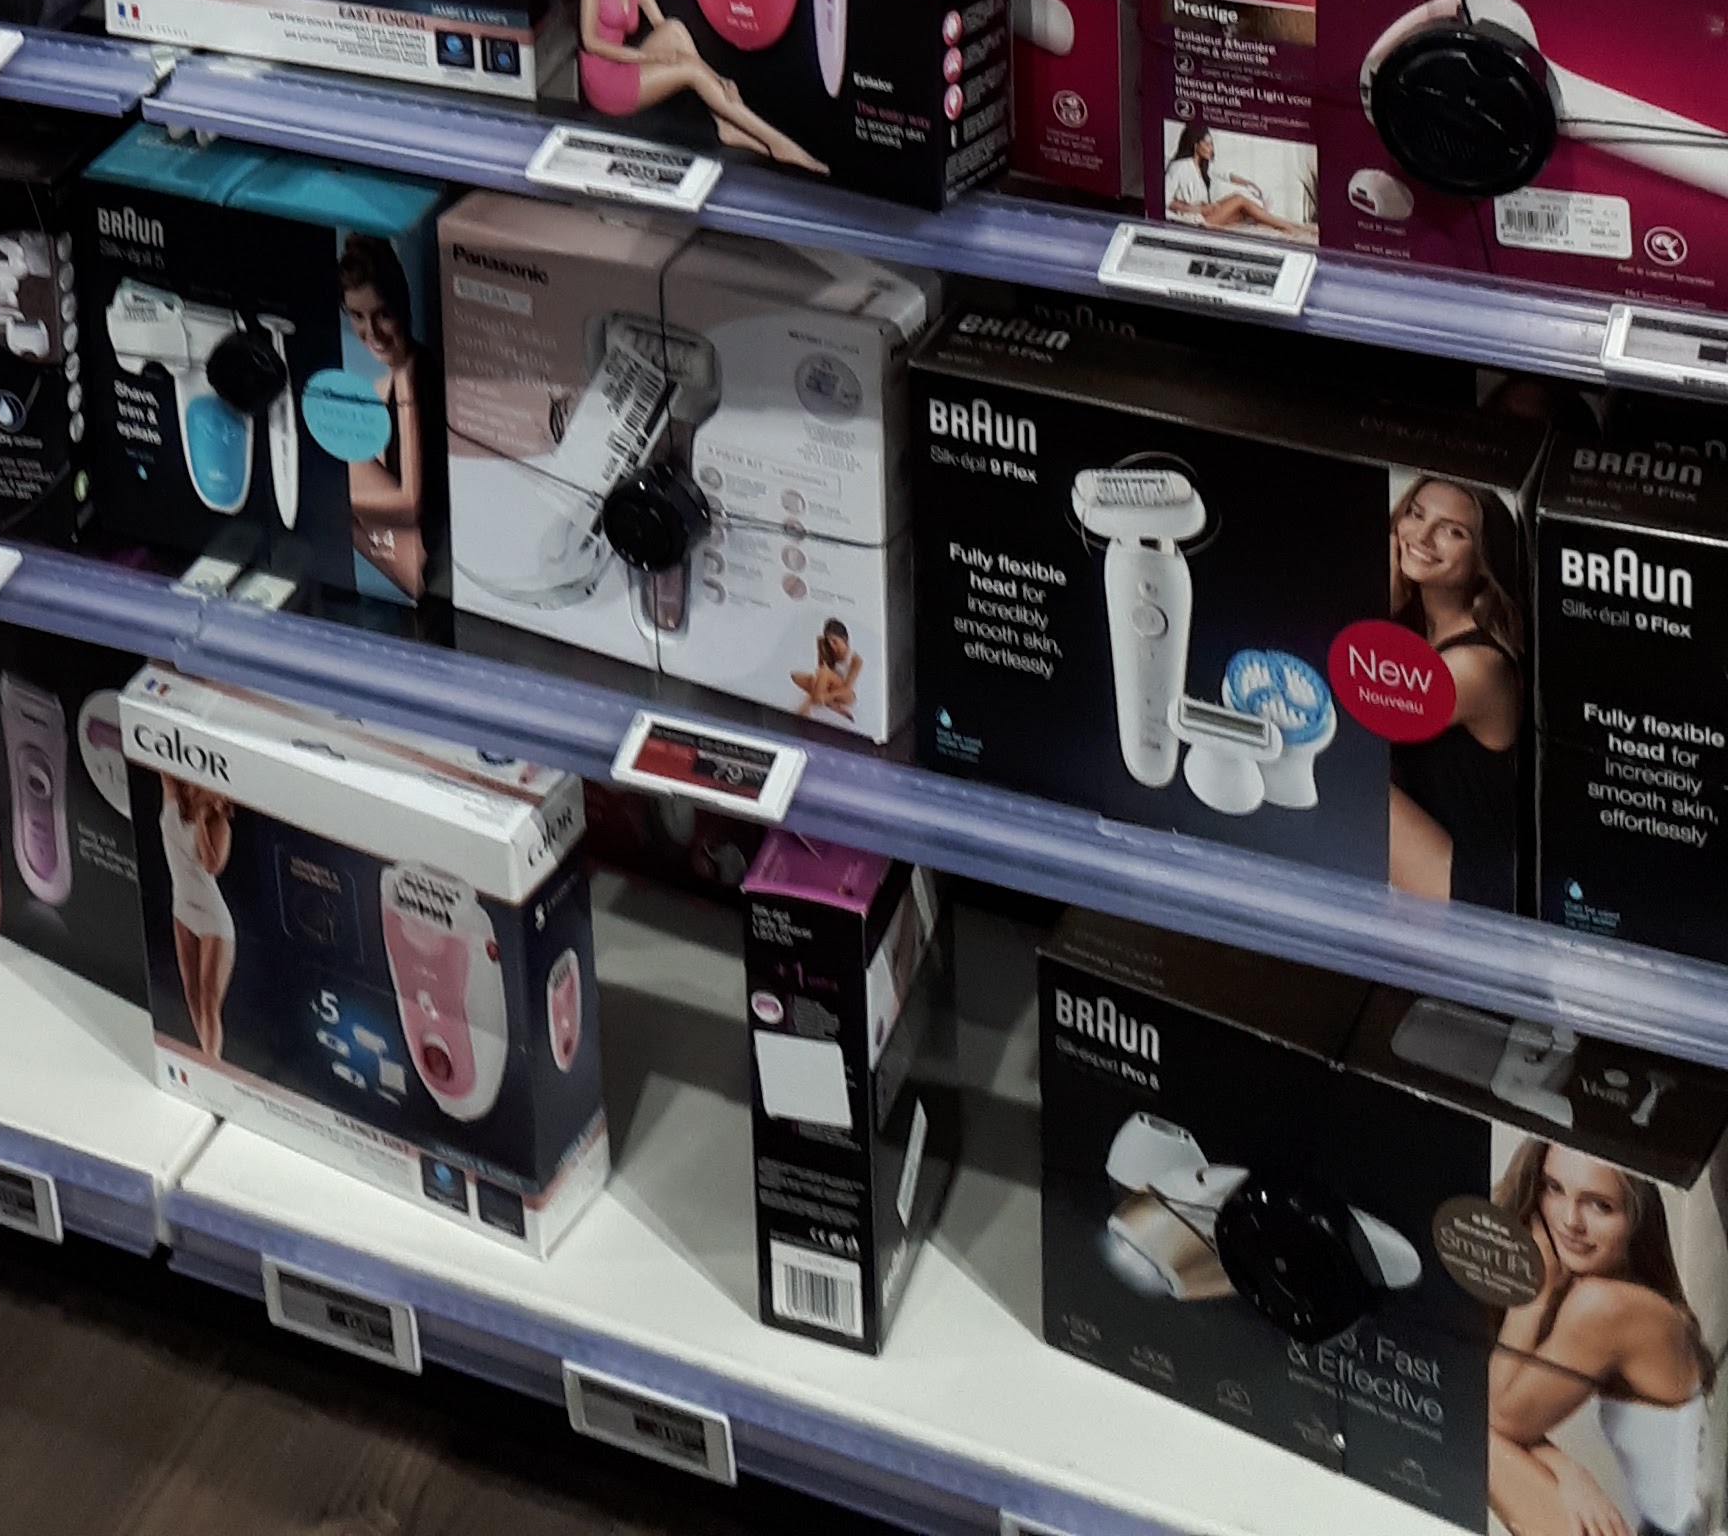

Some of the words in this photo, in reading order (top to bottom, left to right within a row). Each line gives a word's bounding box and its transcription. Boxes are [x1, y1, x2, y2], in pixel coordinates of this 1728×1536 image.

[97, 205, 165, 248] BRAUN
[451, 243, 550, 287] Panasonic
[928, 397, 1039, 456] BRAUN
[1003, 459, 1039, 485] Flex
[1573, 448, 1703, 487] BRAUN
[949, 542, 994, 573] Fully
[998, 550, 1067, 587] flexible
[1560, 548, 1695, 609] BRAUN
[969, 571, 1018, 600] head
[1021, 579, 1047, 605] for
[953, 615, 1021, 645] smooth
[1650, 616, 1693, 641] Flex
[963, 640, 1055, 681] effortlessly
[1347, 643, 1435, 694] New
[1358, 684, 1426, 717] Nouveau
[1582, 702, 1637, 734] Fully
[1642, 713, 1725, 750] flexible
[1607, 732, 1665, 762] head
[1671, 744, 1700, 768] for
[1586, 780, 1667, 813] smooth
[1671, 799, 1719, 825] skin,
[1599, 807, 1709, 848] effortlessly
[1055, 988, 1161, 1065] BRAUN
[1375, 1335, 1442, 1389] Fast
[1318, 1351, 1444, 1422] Effective
